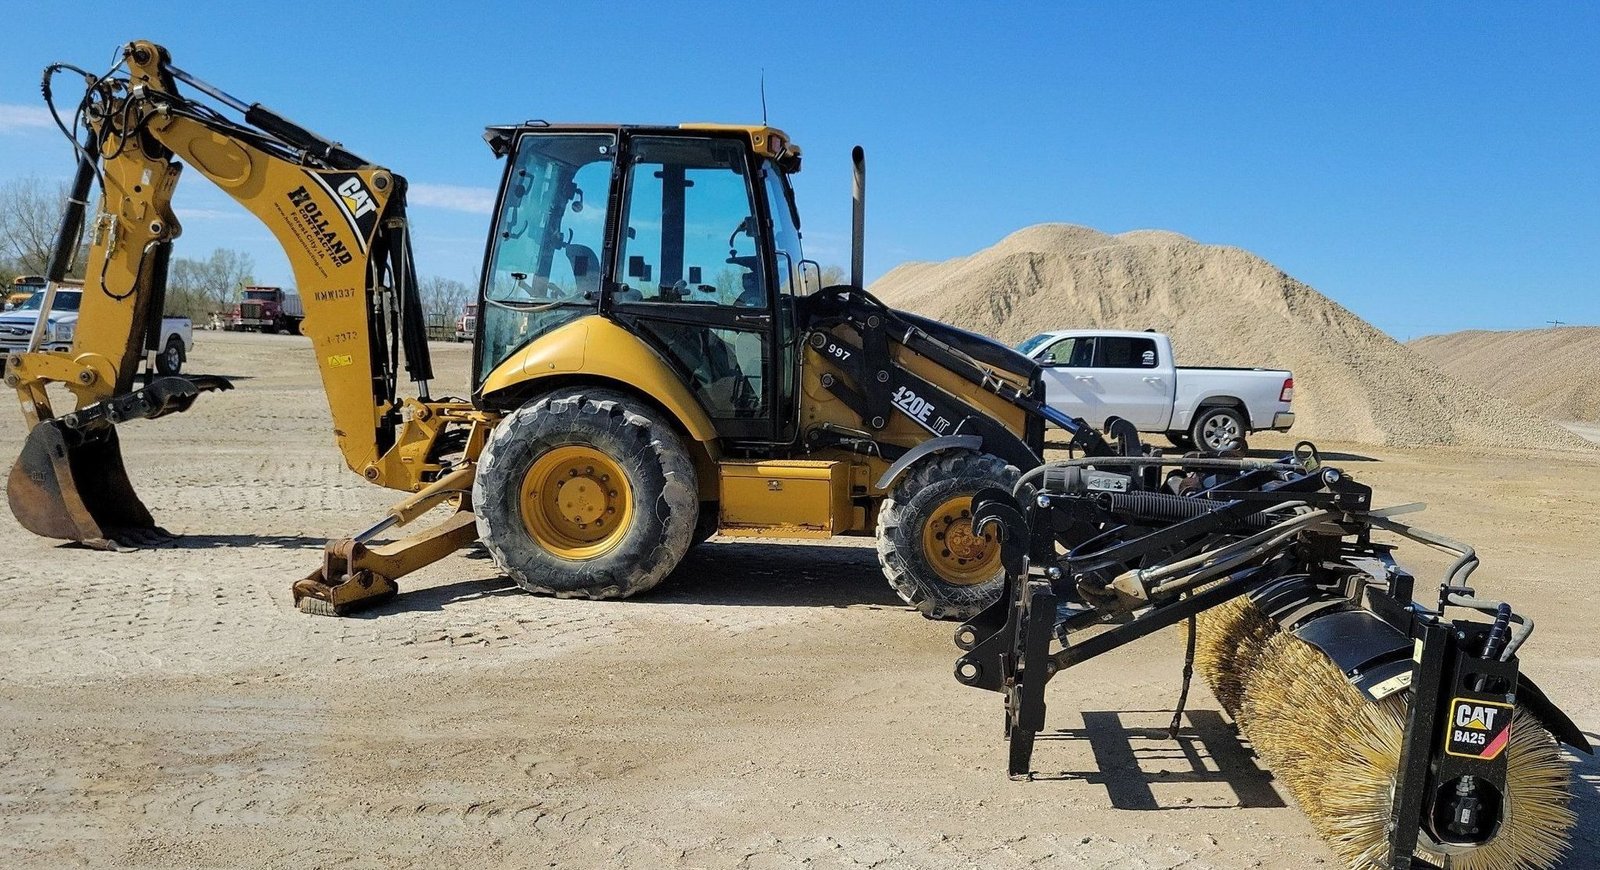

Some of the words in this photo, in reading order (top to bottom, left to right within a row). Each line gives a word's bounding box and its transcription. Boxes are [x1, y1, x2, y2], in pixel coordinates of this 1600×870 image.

[337, 176, 377, 219] CAT
[287, 185, 353, 265] HOLLAND
[290, 211, 308, 235] Forest
[317, 250, 325, 259] IA
[299, 208, 342, 268] CONTRACTING
[827, 343, 851, 361] 997
[891, 385, 935, 422] 420E
[1454, 730, 1486, 745] BA25
[1456, 704, 1498, 731] CAT
